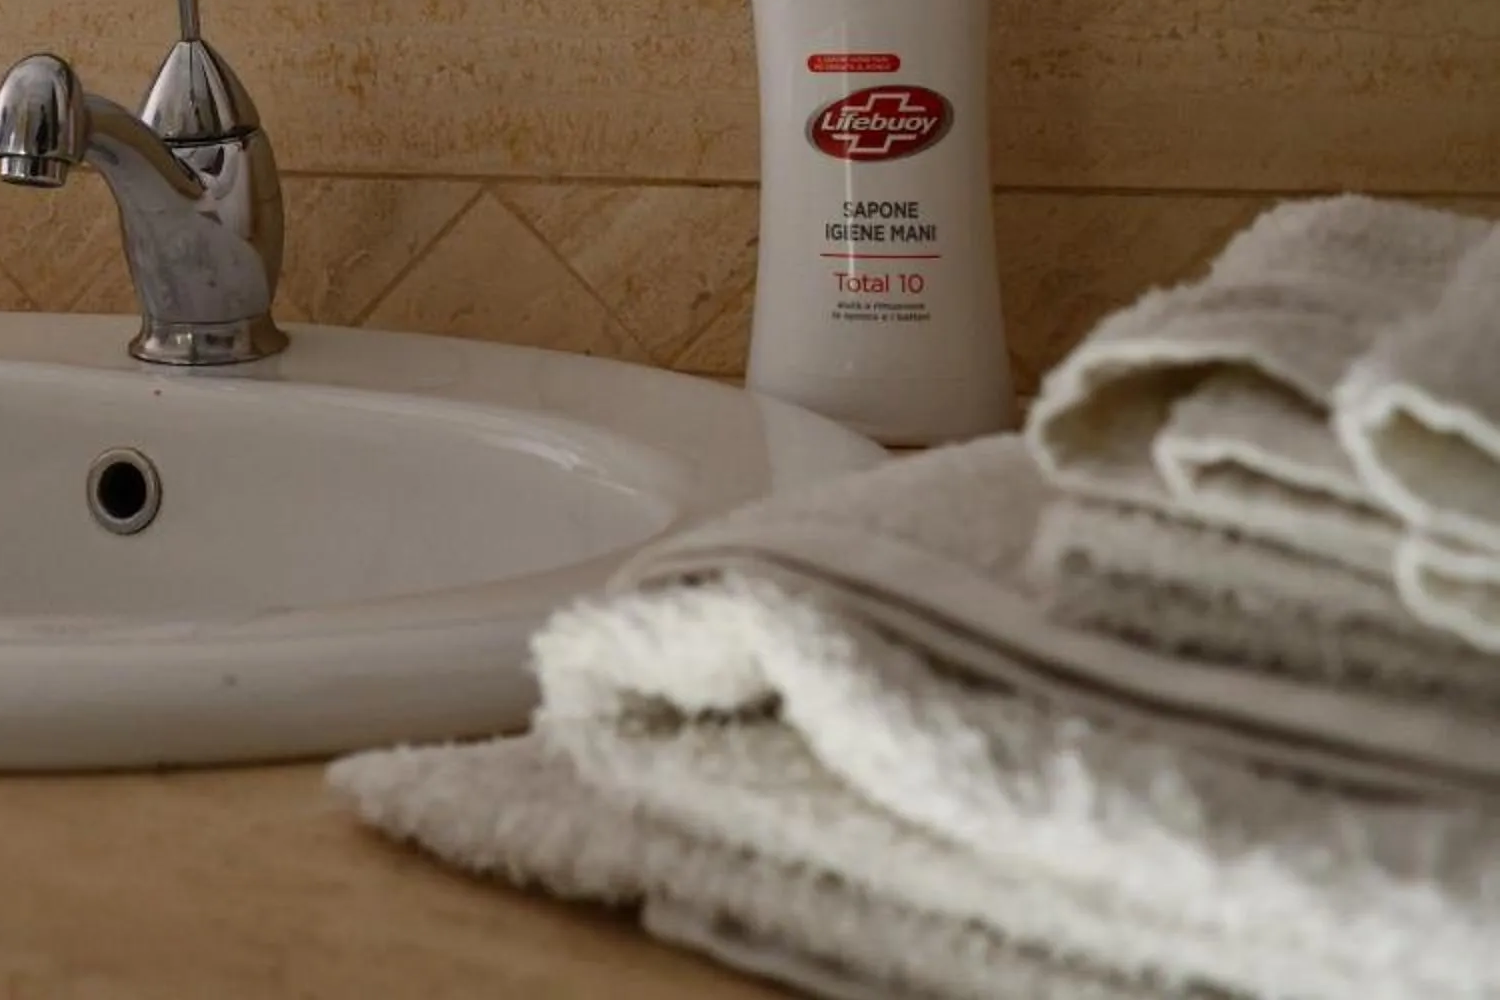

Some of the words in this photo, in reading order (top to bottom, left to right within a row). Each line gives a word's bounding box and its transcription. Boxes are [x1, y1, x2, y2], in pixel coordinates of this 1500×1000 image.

[821, 111, 938, 134] Lifebuoy
[843, 201, 919, 218] SAPONE
[825, 223, 885, 241] IGIENE
[890, 224, 937, 242] MANI
[834, 272, 890, 293] Total
[898, 273, 925, 294] 10
